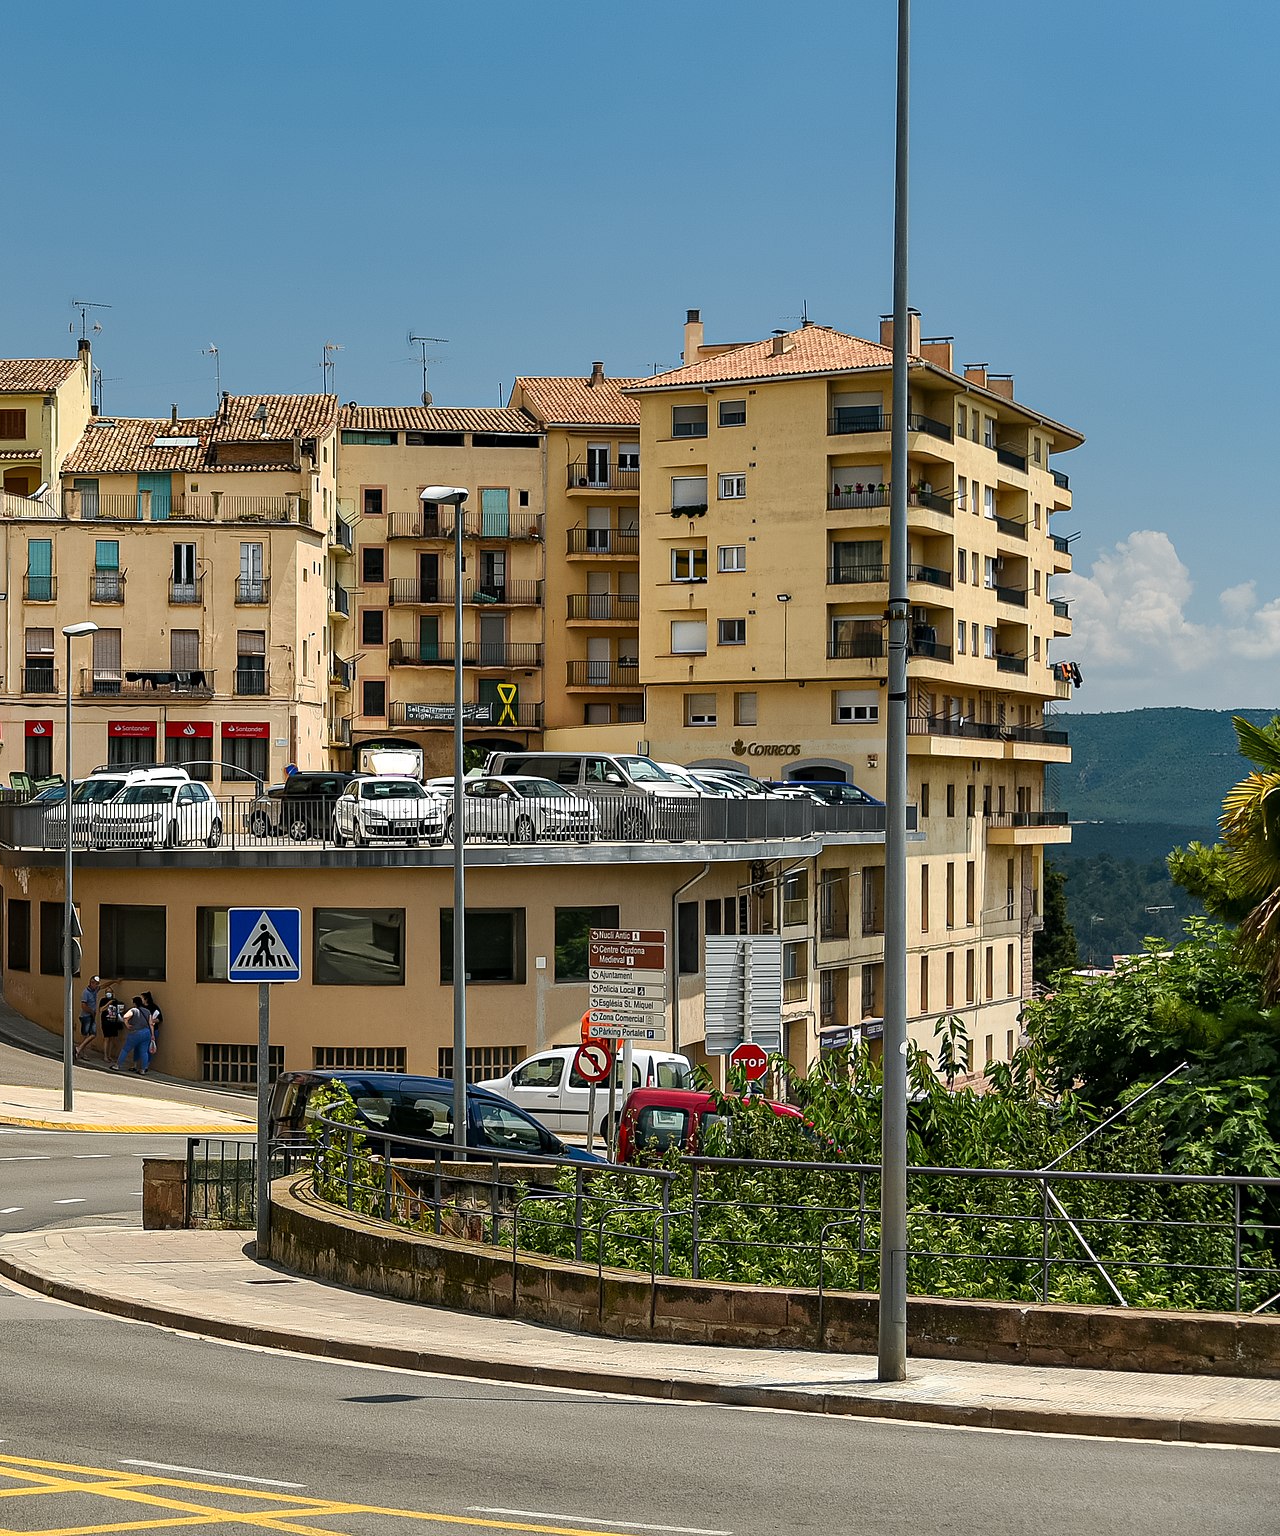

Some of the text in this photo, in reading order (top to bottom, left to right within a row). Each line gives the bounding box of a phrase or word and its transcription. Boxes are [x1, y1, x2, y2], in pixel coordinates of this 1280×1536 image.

[599, 931, 631, 940] Nucli Antic
[599, 946, 645, 955] Centre Cardona
[599, 955, 625, 964] Medieval
[600, 971, 632, 980] Ajuntament
[599, 985, 636, 994] Policia Local
[633, 1001, 654, 1010] Miquel
[599, 1013, 645, 1023] Zona Comercial
[622, 1028, 646, 1037] Portalet
[733, 1058, 765, 1067] STOP
